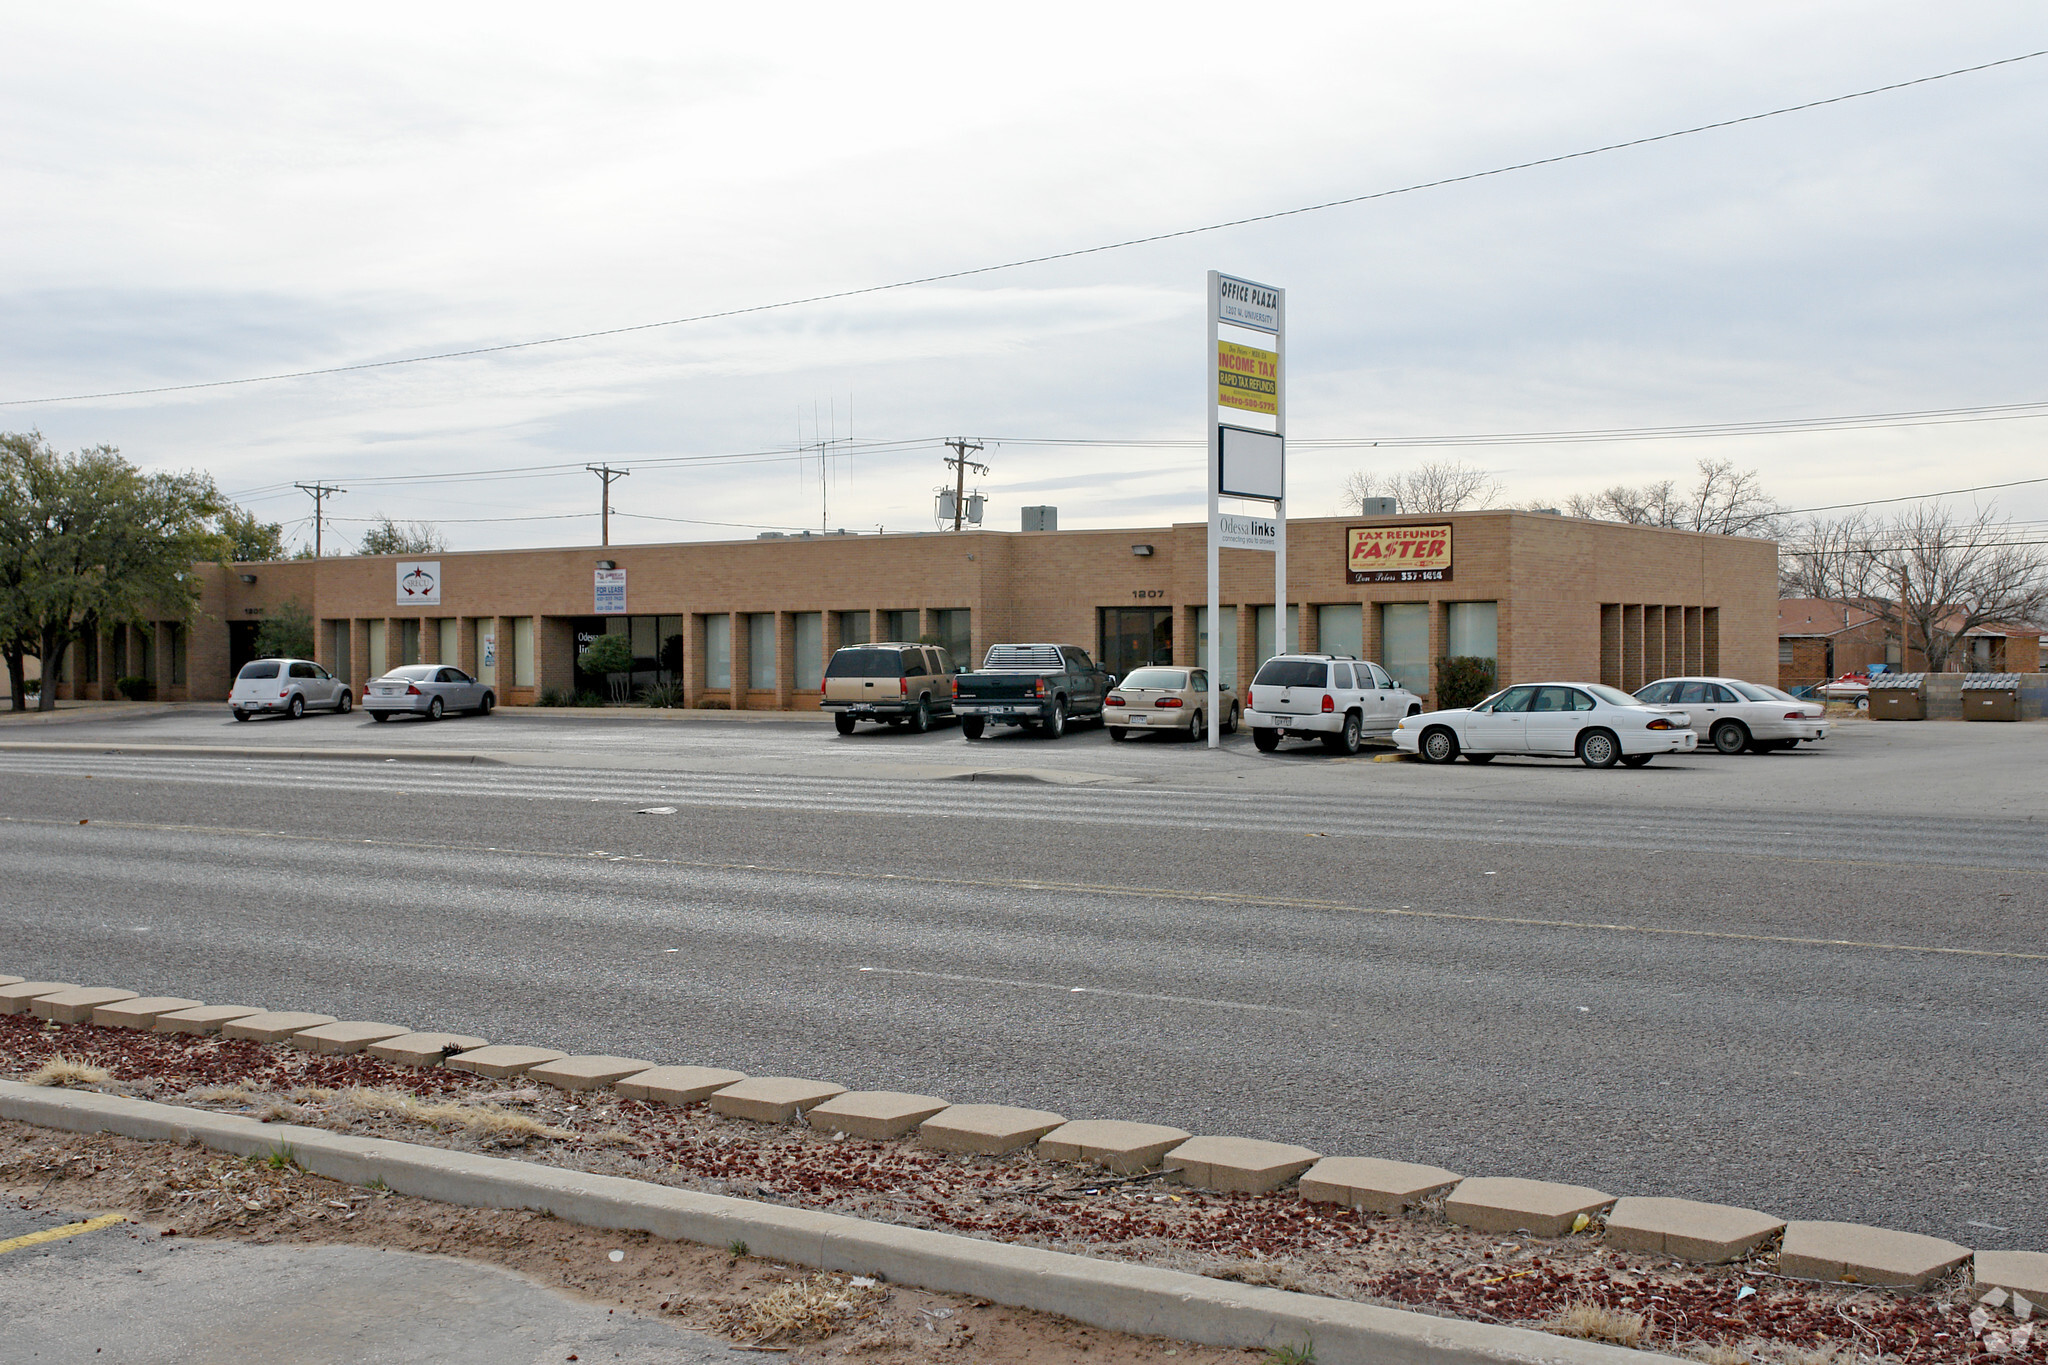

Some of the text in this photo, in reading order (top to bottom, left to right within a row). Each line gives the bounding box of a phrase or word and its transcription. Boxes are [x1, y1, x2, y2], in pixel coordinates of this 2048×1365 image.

[1222, 281, 1276, 310] OFFICE PLAZA
[1245, 309, 1272, 324] UNIVERSITY
[1219, 352, 1275, 378] INCOME TAX
[1220, 372, 1274, 393] RAPID TAX REFUNDS
[1220, 517, 1275, 536] Odessa links
[1356, 529, 1446, 540] TAX REFUNDS
[1132, 590, 1164, 598] 1207
[579, 645, 590, 653] lin
